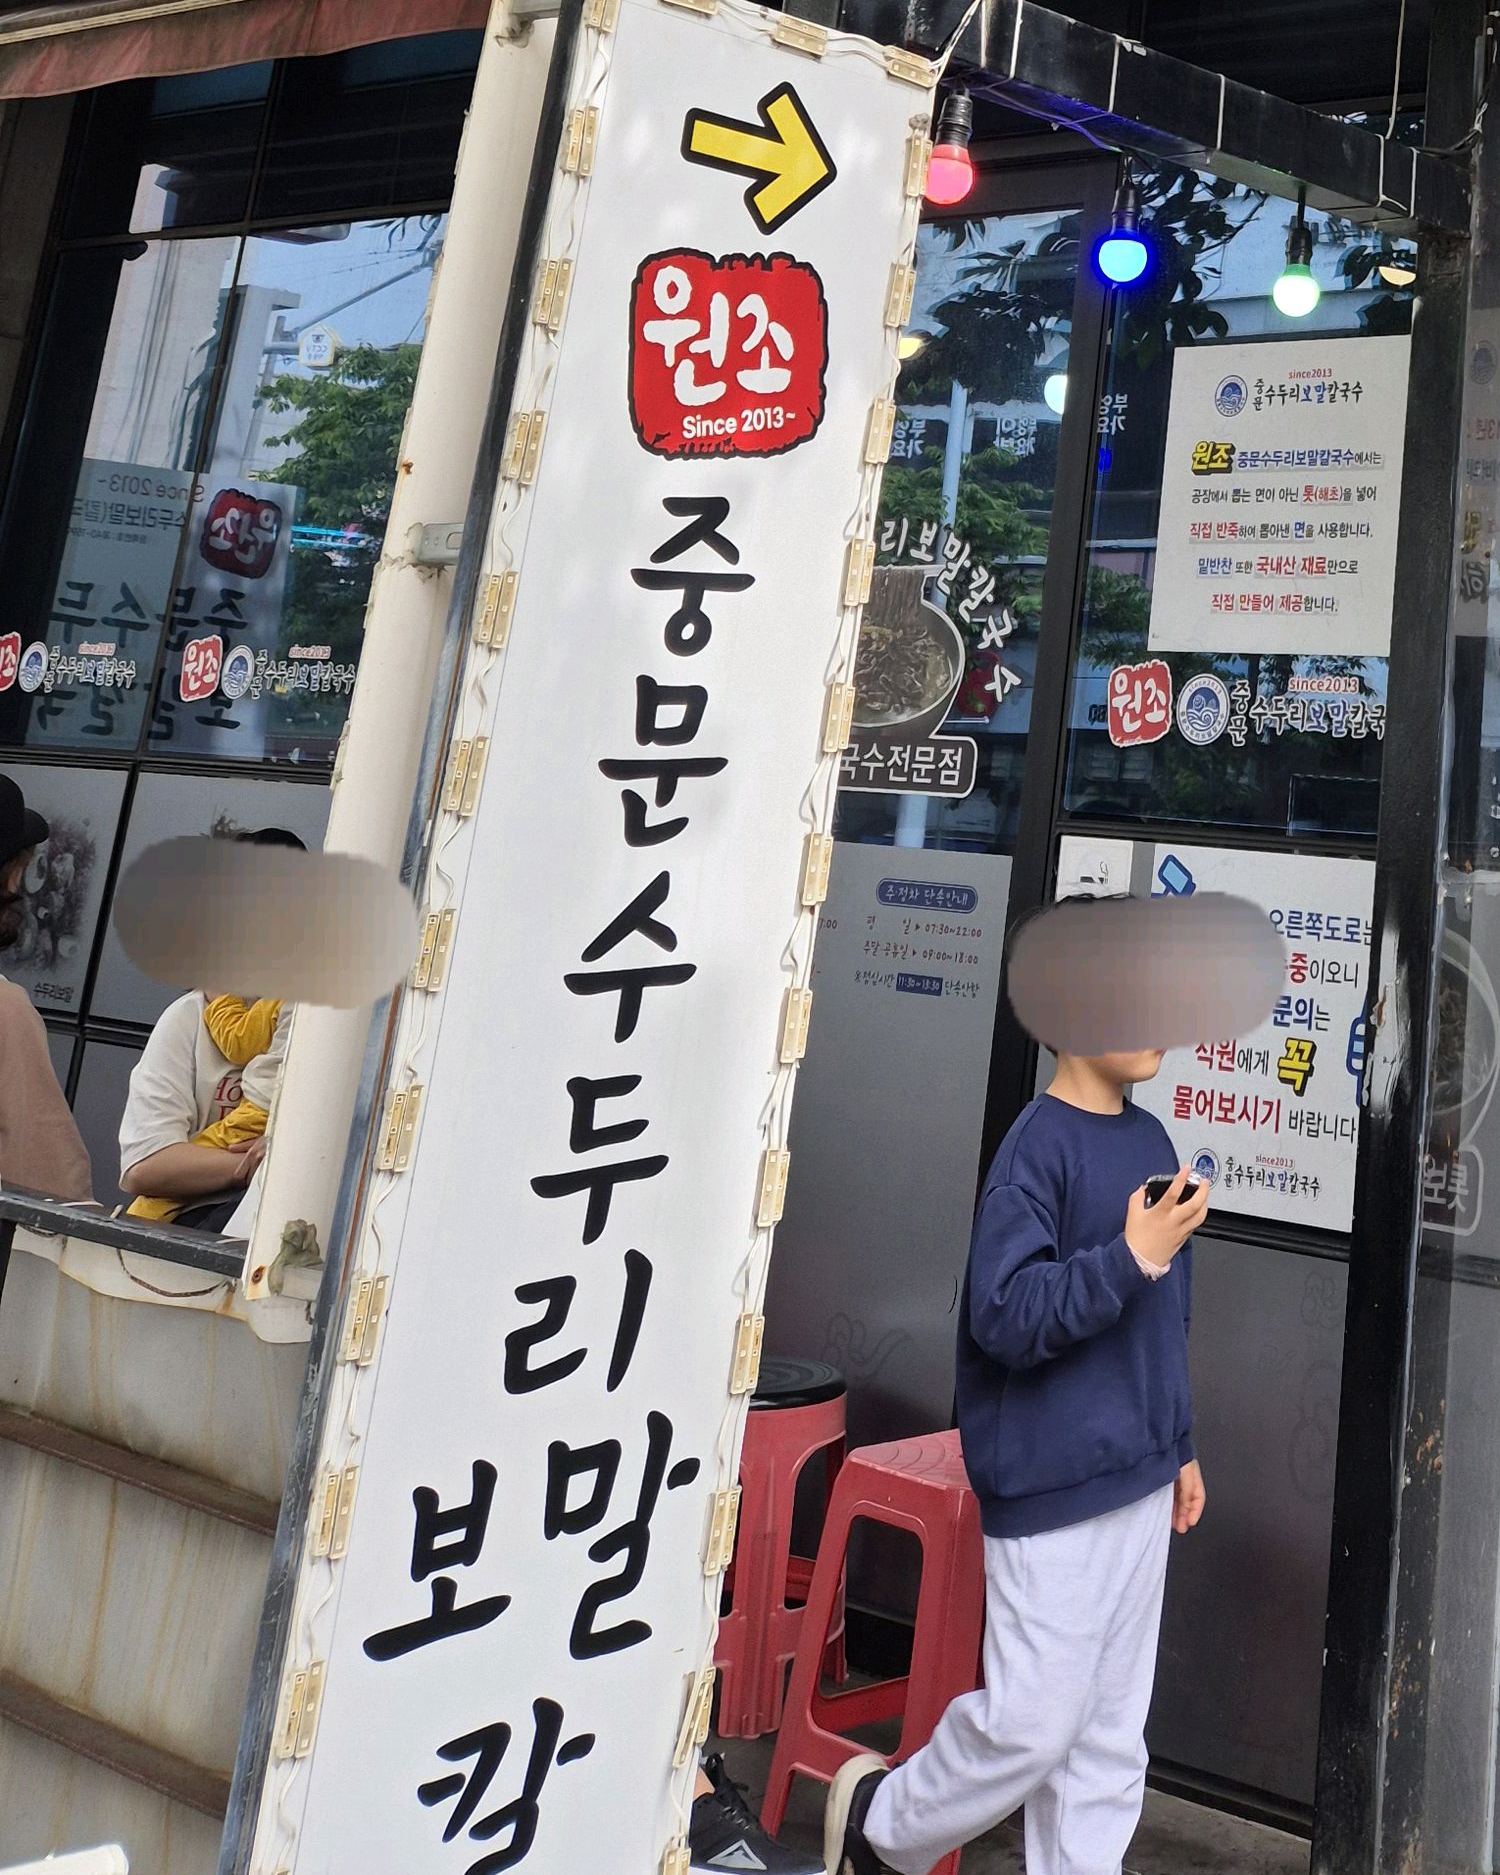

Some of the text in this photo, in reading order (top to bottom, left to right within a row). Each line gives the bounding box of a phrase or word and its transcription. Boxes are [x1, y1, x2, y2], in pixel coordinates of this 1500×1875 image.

[642, 265, 795, 407] 원조
[1288, 368, 1333, 379] since2013
[1264, 380, 1363, 407] 수두리보말칼국수
[681, 415, 737, 439] Since
[1192, 440, 1382, 473] 원조 중문수두리보말칼국수에서는
[1191, 488, 1228, 503] 공장에서
[1255, 488, 1275, 502] 면이
[1278, 487, 1299, 502] 아닌
[1302, 485, 1352, 503] 톳(해초)을
[1356, 486, 1377, 501] 넣어
[1190, 521, 1374, 539] 직접 반죽하여 뽑아낸 면을 사용합니다.
[1198, 555, 1359, 575] 밑반찬 또한 국내산 재료만으로
[1211, 594, 1338, 612] 직접 만들어 제공합니다.
[184, 645, 219, 691] 원조
[1288, 676, 1360, 694] since2013
[1112, 672, 1167, 734] 원조
[1284, 953, 1359, 989] 중이오니
[1276, 1037, 1317, 1097] 꼭
[1172, 1085, 1357, 1144] 물어보시기 바랍니다
[1255, 1154, 1294, 1168] since2013
